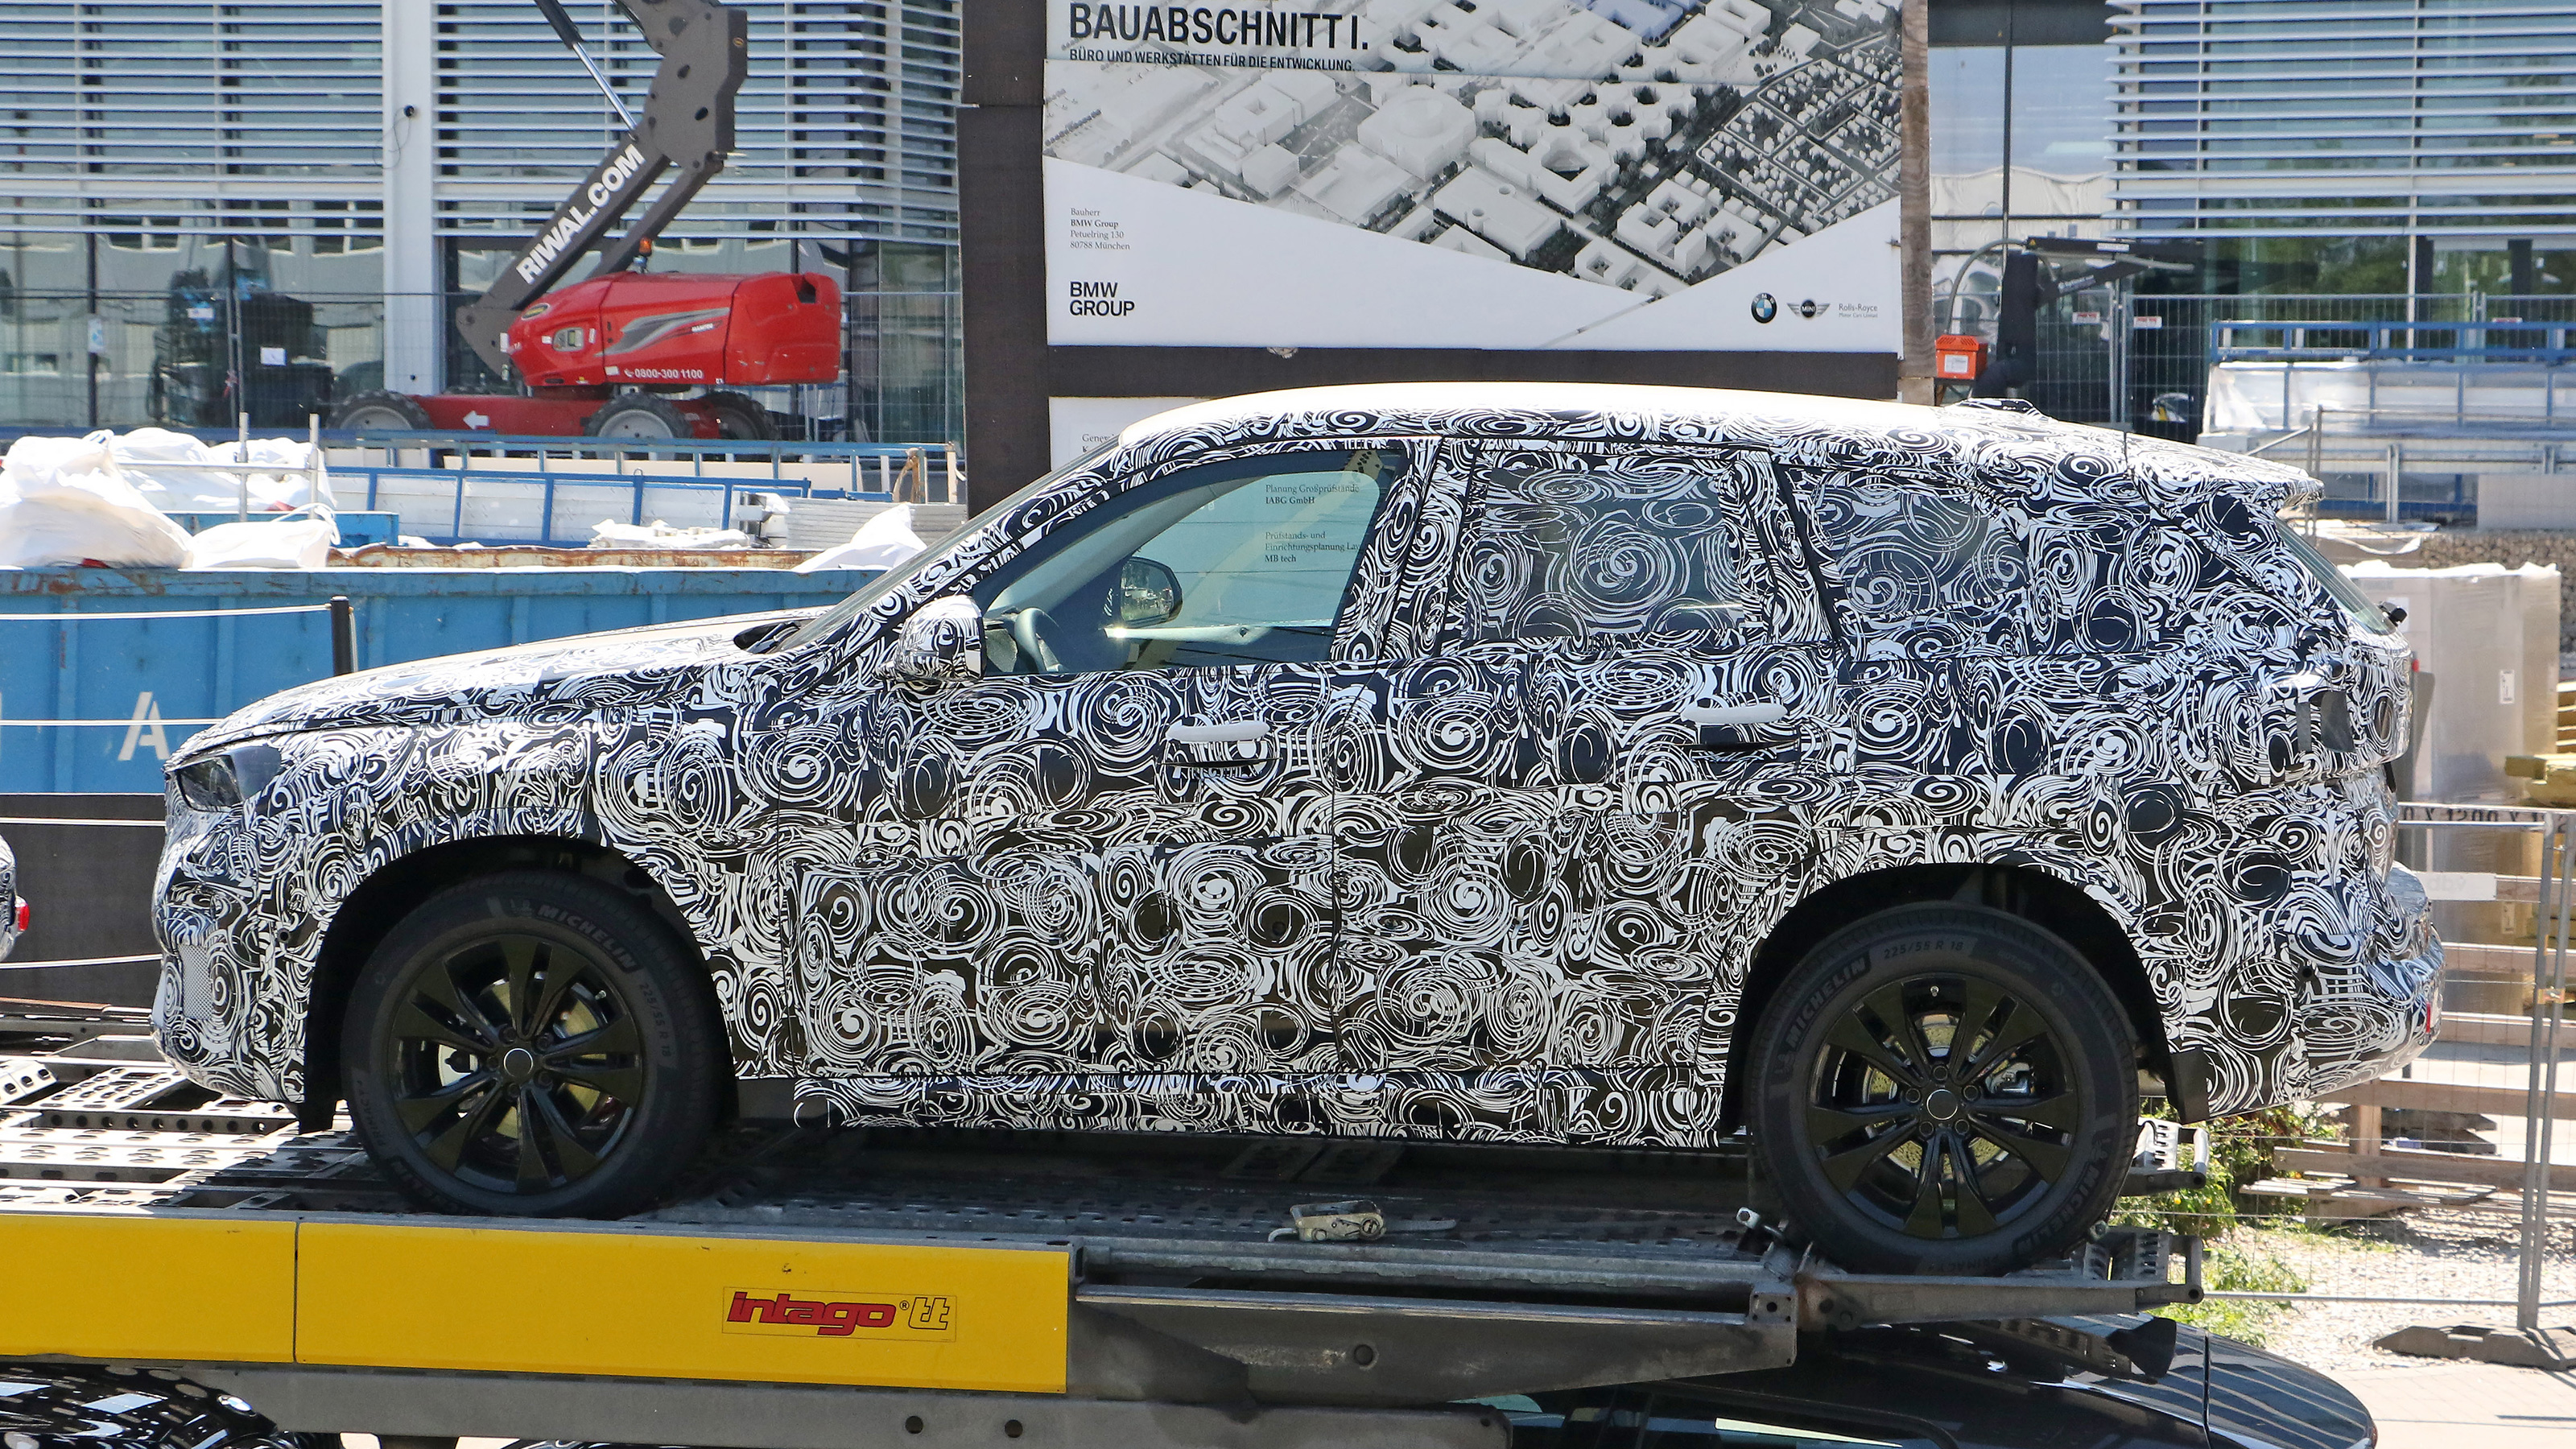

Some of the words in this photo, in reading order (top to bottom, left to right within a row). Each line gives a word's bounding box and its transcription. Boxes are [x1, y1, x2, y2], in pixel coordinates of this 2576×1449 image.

[1070, 2, 1343, 49] BAUABSCHNITT
[1351, 14, 1368, 50] I.
[1070, 47, 1104, 61] BÜRO
[1107, 50, 1132, 63] UND
[1135, 51, 1221, 66] WERKSTÄTTEN
[1224, 52, 1245, 67] FÜR
[1249, 56, 1267, 68] DIE
[1269, 56, 1356, 72] ENTWICKLUNG.
[516, 144, 646, 284] RIWAL.COM
[1071, 208, 1100, 217] Bauherr
[1071, 219, 1092, 227] BMW
[1094, 220, 1119, 229] Group
[1071, 229, 1108, 240] Petuelring
[1111, 231, 1125, 239] 130
[1070, 241, 1093, 249] 80788
[1095, 242, 1130, 250] München
[1069, 281, 1118, 298] BMW
[1069, 299, 1135, 316] GROUP
[1839, 303, 1878, 314] Rolls-Royce
[634, 368, 679, 379] 0800-300
[680, 369, 704, 379] 1100
[1265, 484, 1297, 494] Planung
[1299, 484, 1360, 494] Großprüfstände
[1289, 496, 1315, 504] GmbH
[1311, 531, 1326, 539] und
[1265, 543, 1345, 553] Einrichtungsplanung
[1281, 554, 1297, 562] tech
[118, 691, 170, 761] A
[538, 903, 637, 972] MICHELIN
[1950, 940, 1964, 952] 18
[1784, 956, 1866, 1046] MICHELIN
[727, 1291, 897, 1335] intago
